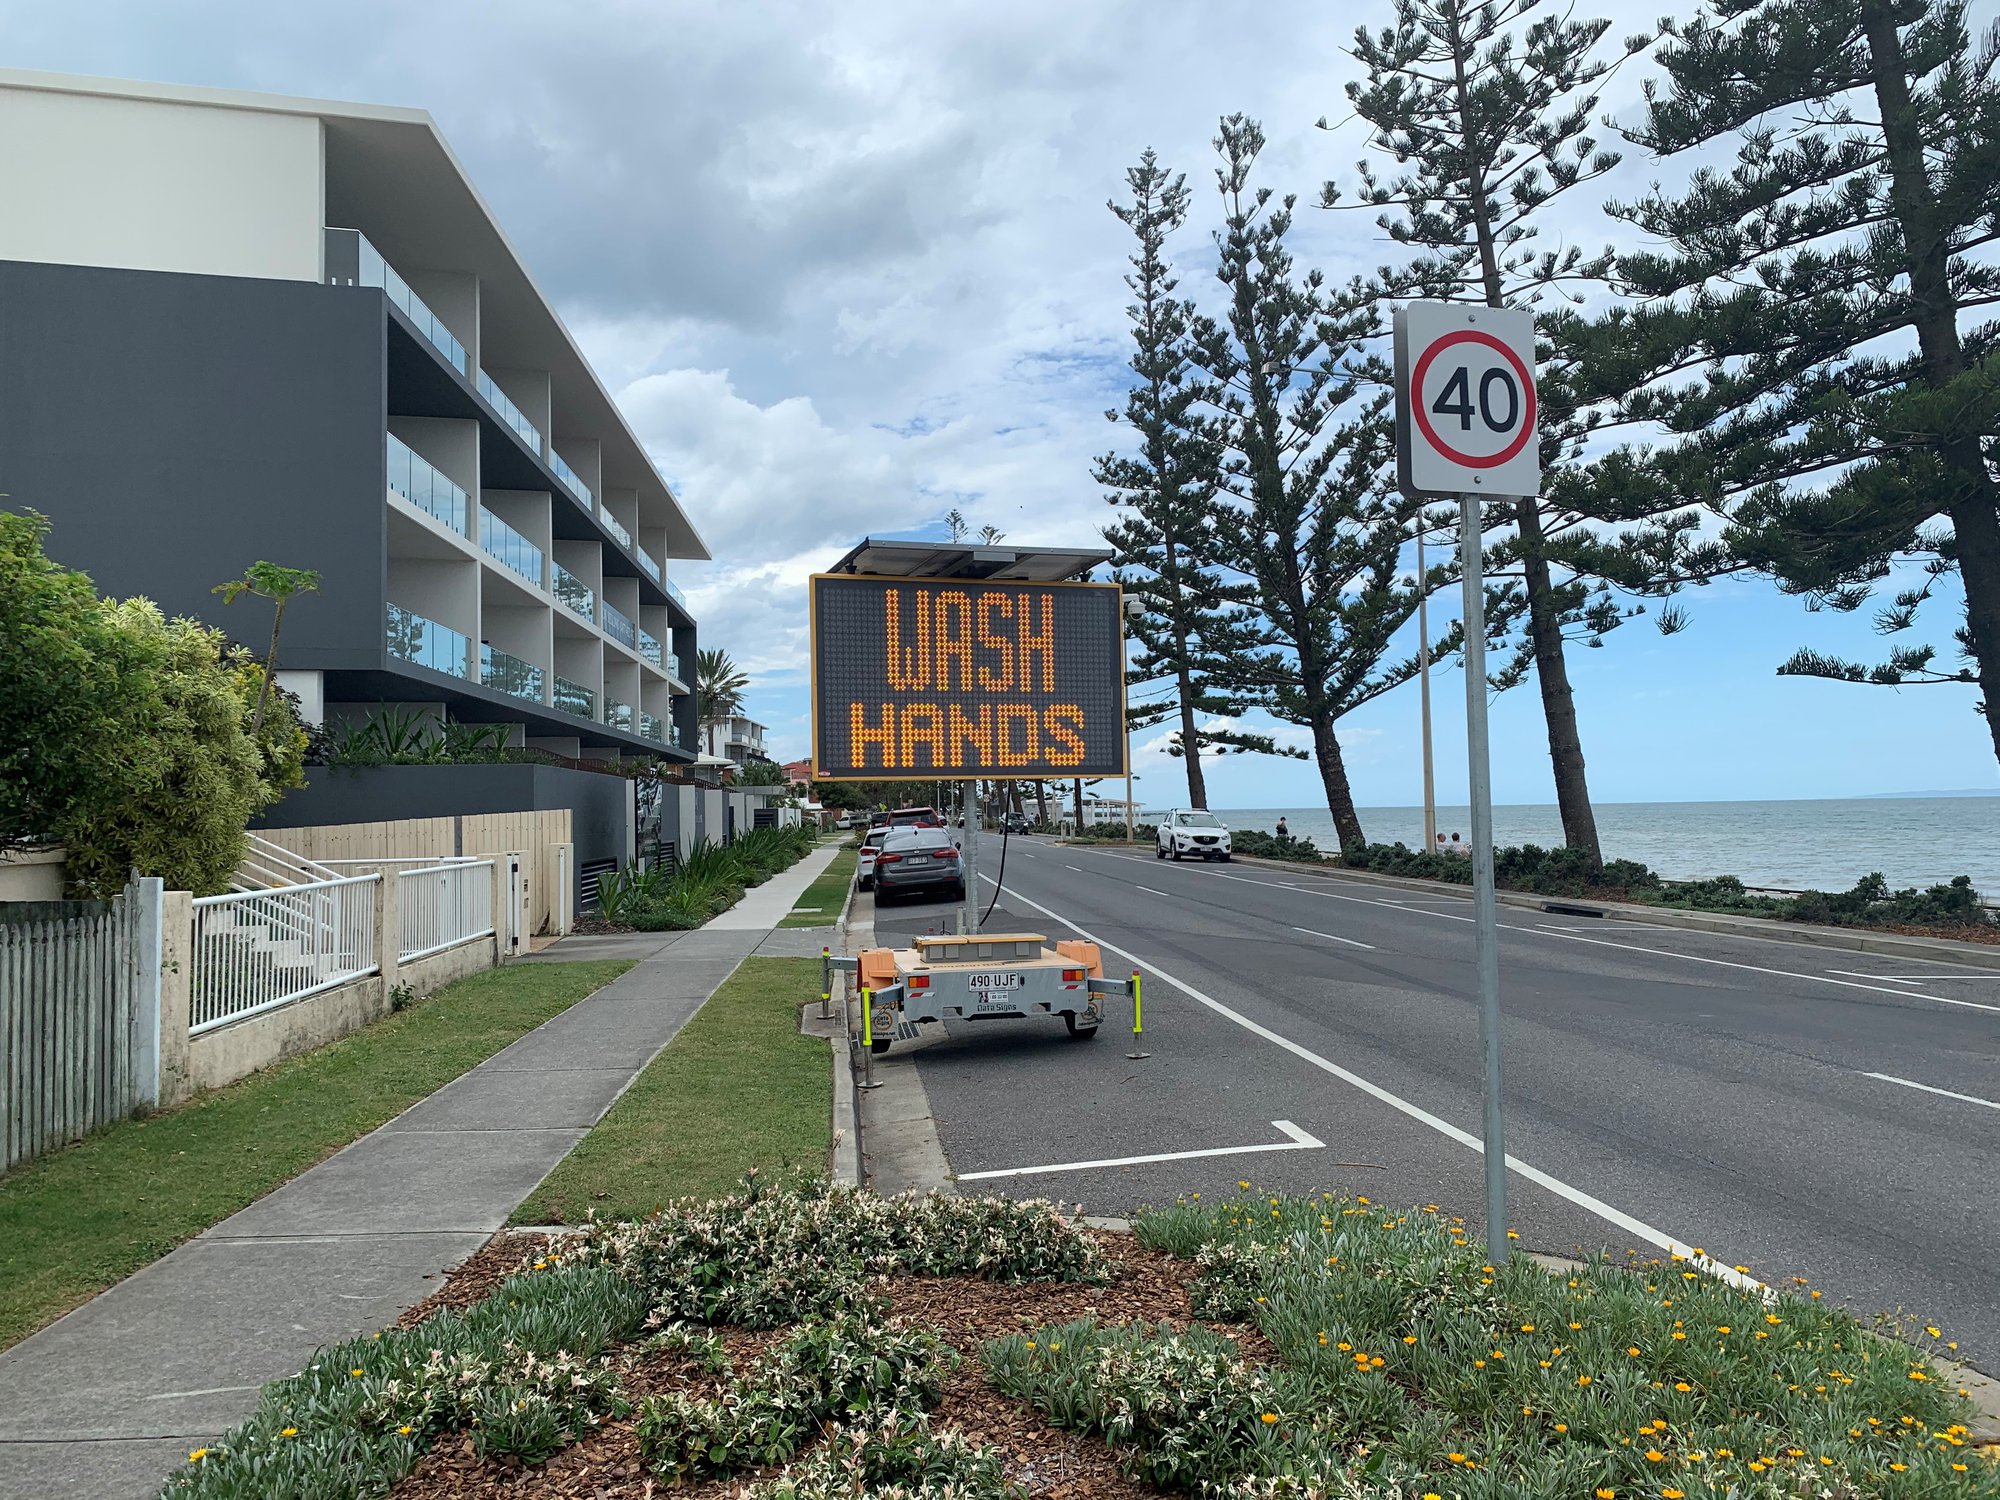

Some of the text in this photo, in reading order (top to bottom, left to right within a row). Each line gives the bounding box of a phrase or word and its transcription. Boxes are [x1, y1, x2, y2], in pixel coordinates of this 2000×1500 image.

[1432, 366, 1519, 434] 40
[885, 588, 1055, 693] WASH
[850, 702, 1085, 768] HANDS
[977, 1003, 1017, 1012] Data Signs
